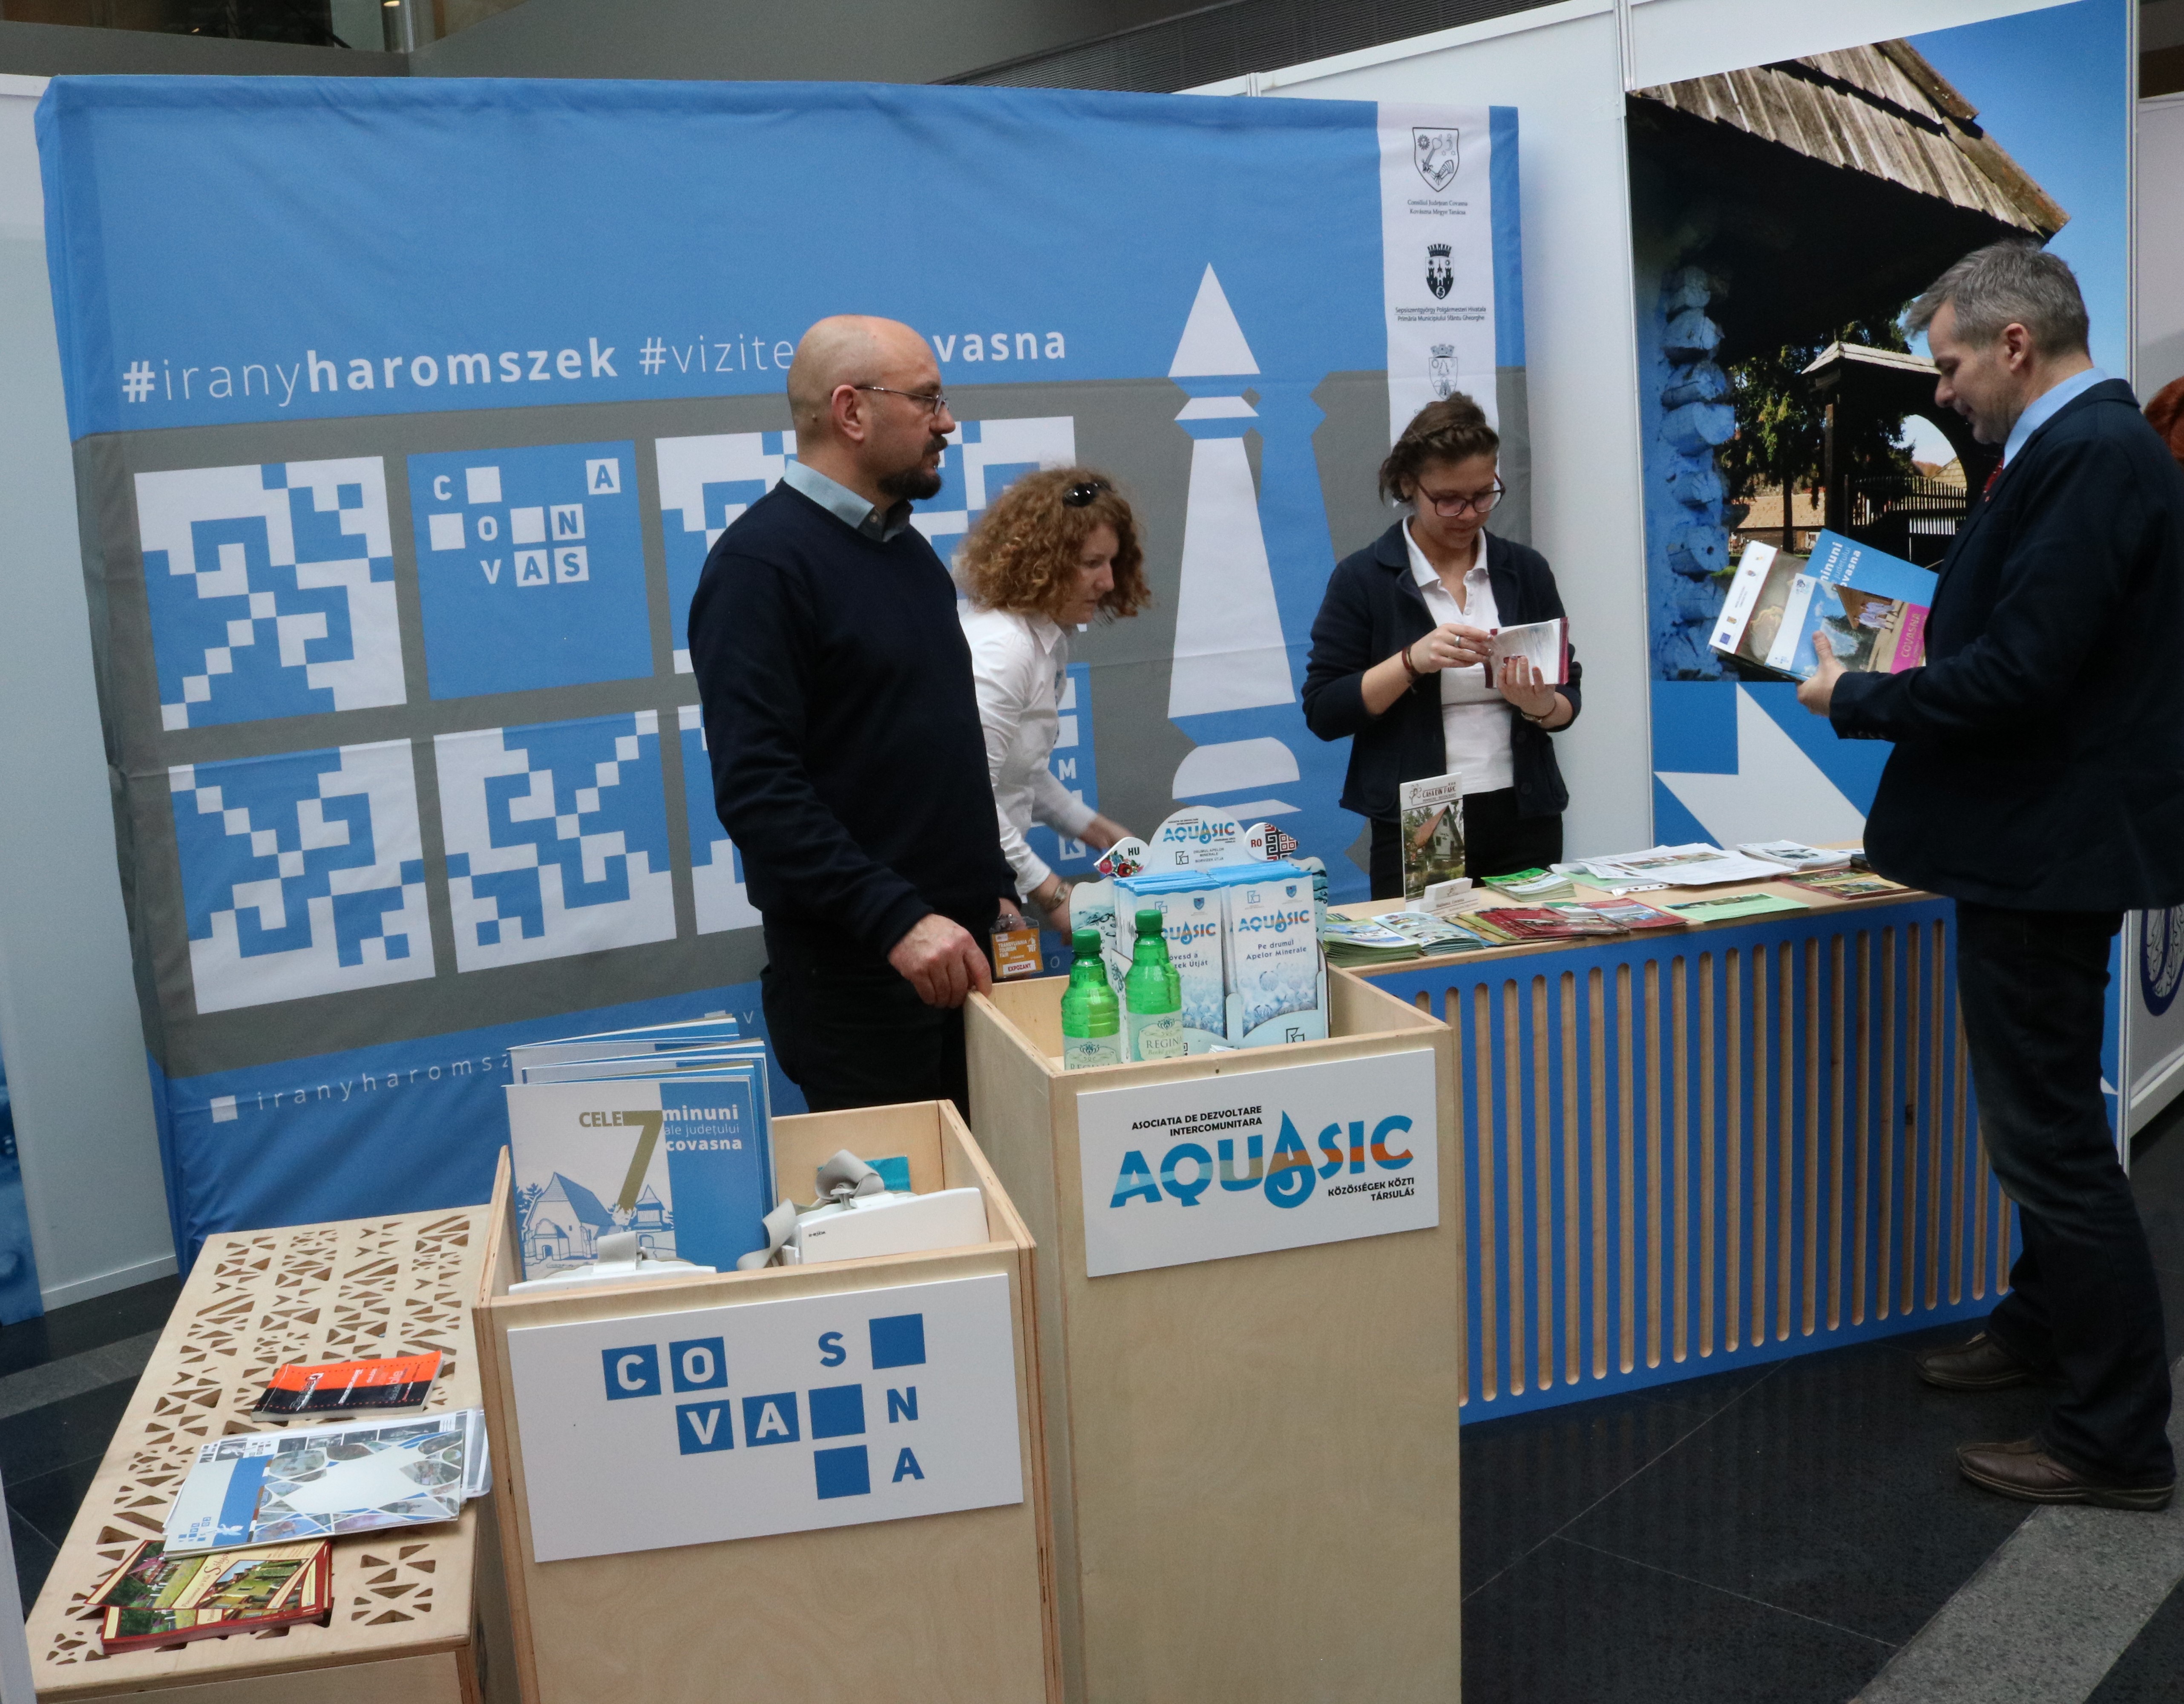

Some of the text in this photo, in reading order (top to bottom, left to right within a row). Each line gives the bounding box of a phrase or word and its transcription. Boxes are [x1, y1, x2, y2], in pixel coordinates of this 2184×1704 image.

[122, 337, 619, 406] #iranyharomszek
[1840, 550, 1861, 587] ovasna
[1901, 613, 1921, 658] COVASNA
[1163, 820, 1235, 844] AQUASIC
[1128, 847, 1140, 856] HU
[1251, 839, 1262, 848] RO
[1238, 910, 1309, 933] AQUASIC
[1269, 939, 1294, 949] drumul
[1275, 947, 1306, 956] Minerale
[1008, 963, 1031, 972] EXPOZANT
[257, 1053, 509, 1110] iranyharomsz
[1131, 1105, 1262, 1130] ASOCIATIA DE DEZVOLTARE
[1169, 1117, 1263, 1137] INTERCOMUNITARA
[665, 1123, 740, 1137] ale județului
[665, 1138, 742, 1151] covasna
[579, 1104, 739, 1215] CELE 7 minuni
[1110, 1110, 1414, 1209] AQUASIC
[1328, 1177, 1415, 1197] KÖZÖSSÉGEK KÖZTI
[1370, 1187, 1415, 1201] TÁRSULÁS
[204, 1553, 230, 1575] Sólyo
